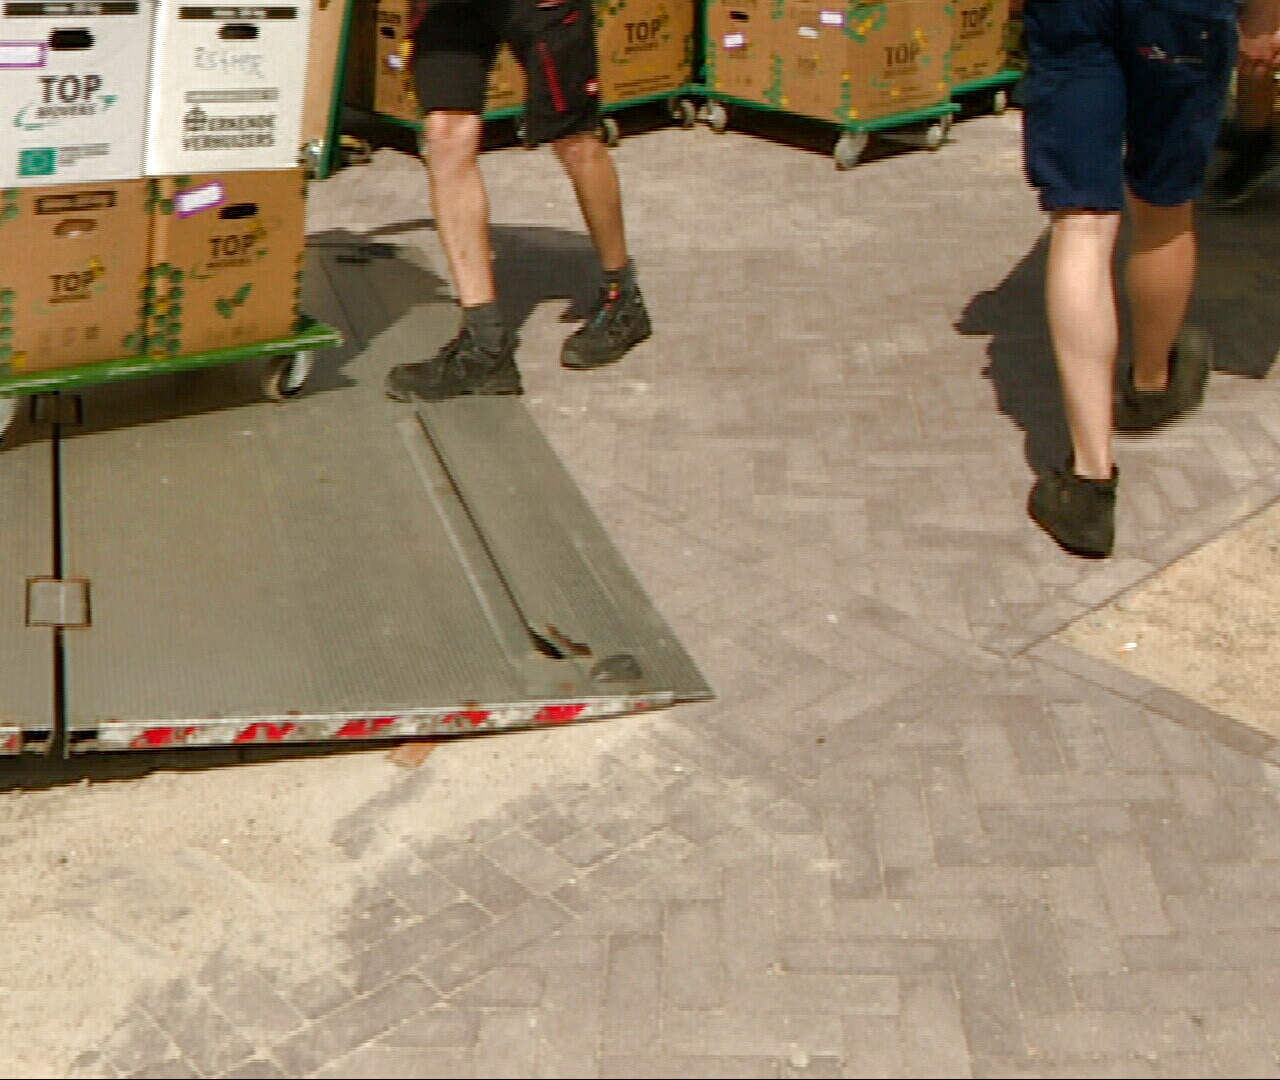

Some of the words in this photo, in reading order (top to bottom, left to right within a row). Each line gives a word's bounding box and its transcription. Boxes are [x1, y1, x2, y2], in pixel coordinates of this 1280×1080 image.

[960, 8, 986, 29] TOP
[624, 22, 660, 43] TOP
[884, 43, 920, 67] TOP
[38, 75, 102, 103] TOP
[209, 234, 256, 258] TOP
[49, 270, 95, 294] TOP
